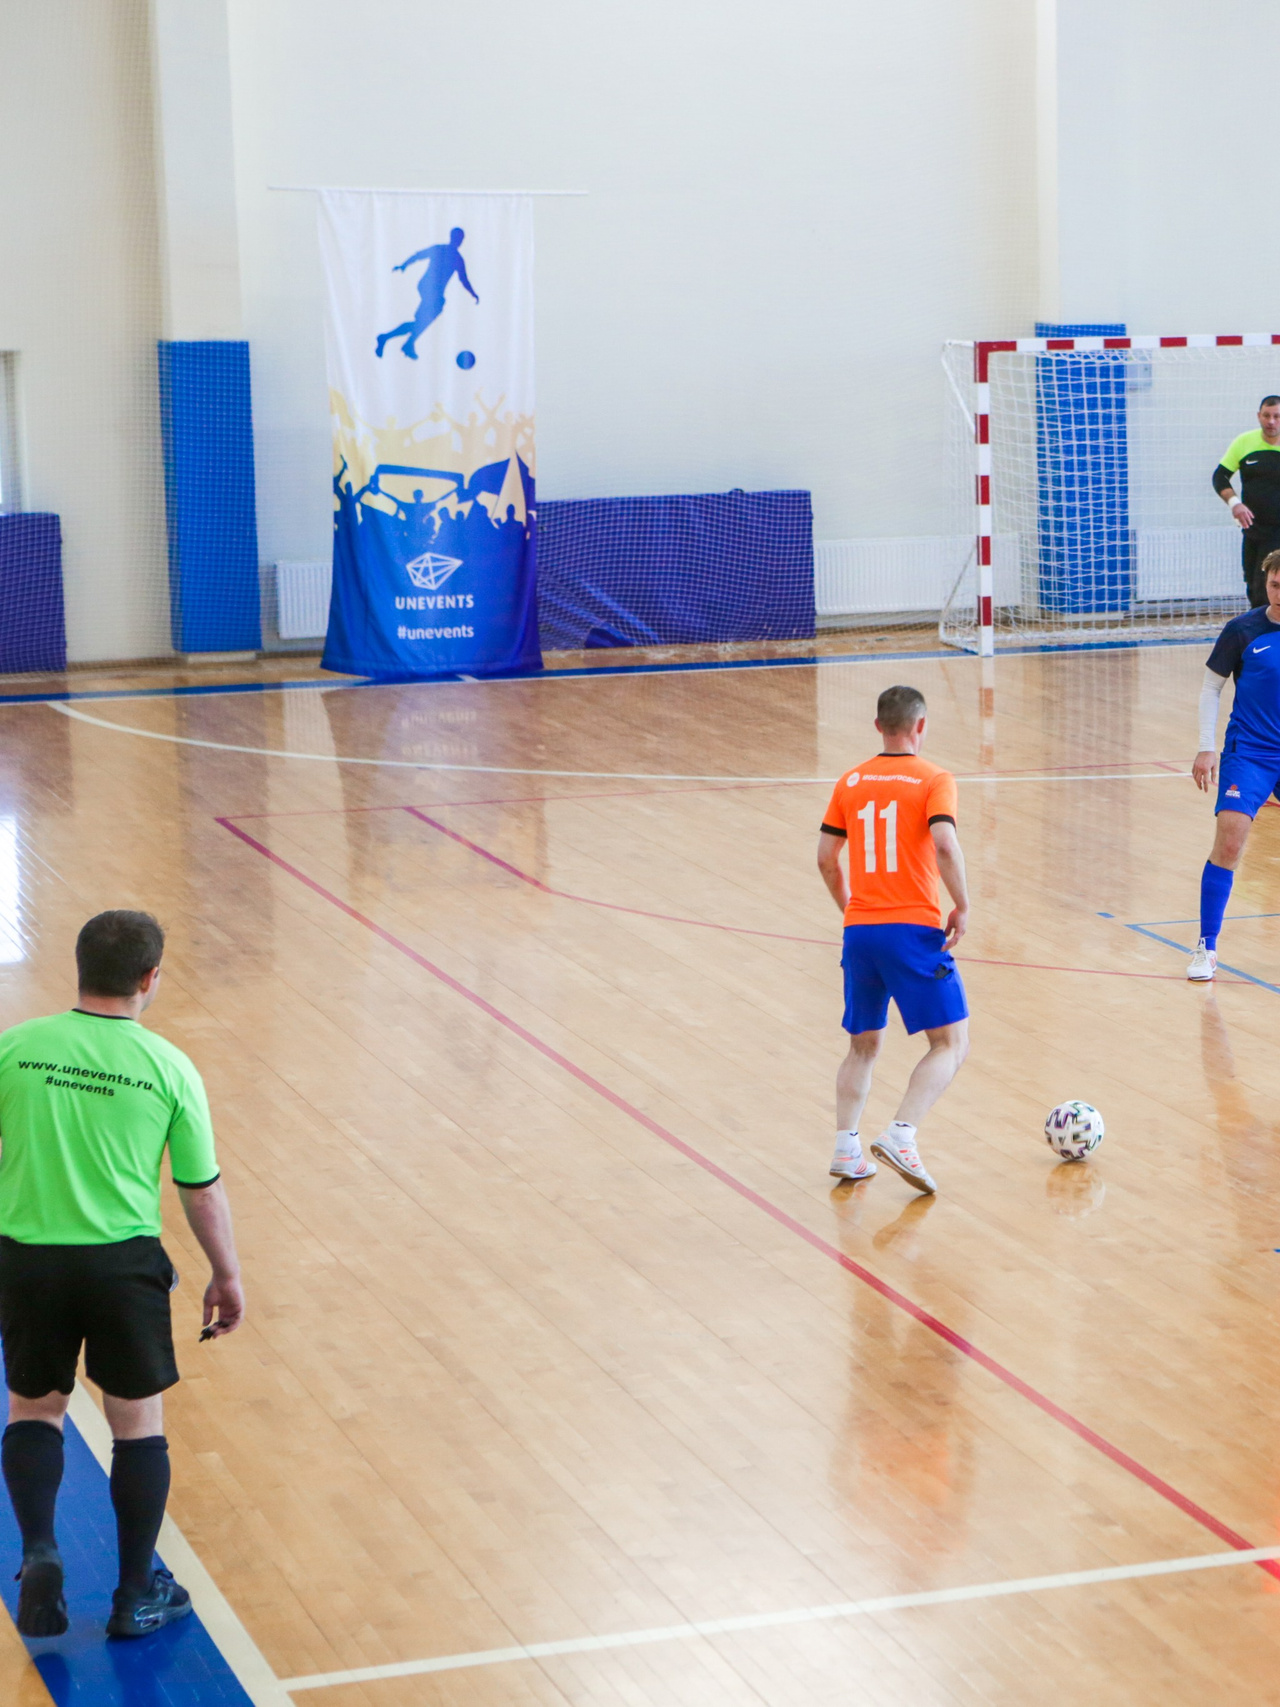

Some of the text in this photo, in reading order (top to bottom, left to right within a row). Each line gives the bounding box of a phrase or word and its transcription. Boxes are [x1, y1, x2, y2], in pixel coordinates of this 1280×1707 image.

[395, 594, 475, 611] UNEVENTS
[397, 624, 475, 640] #unevents
[857, 800, 898, 873] 11
[18, 1060, 153, 1091] www.unevents.ru
[45, 1075, 115, 1097] #unevents
